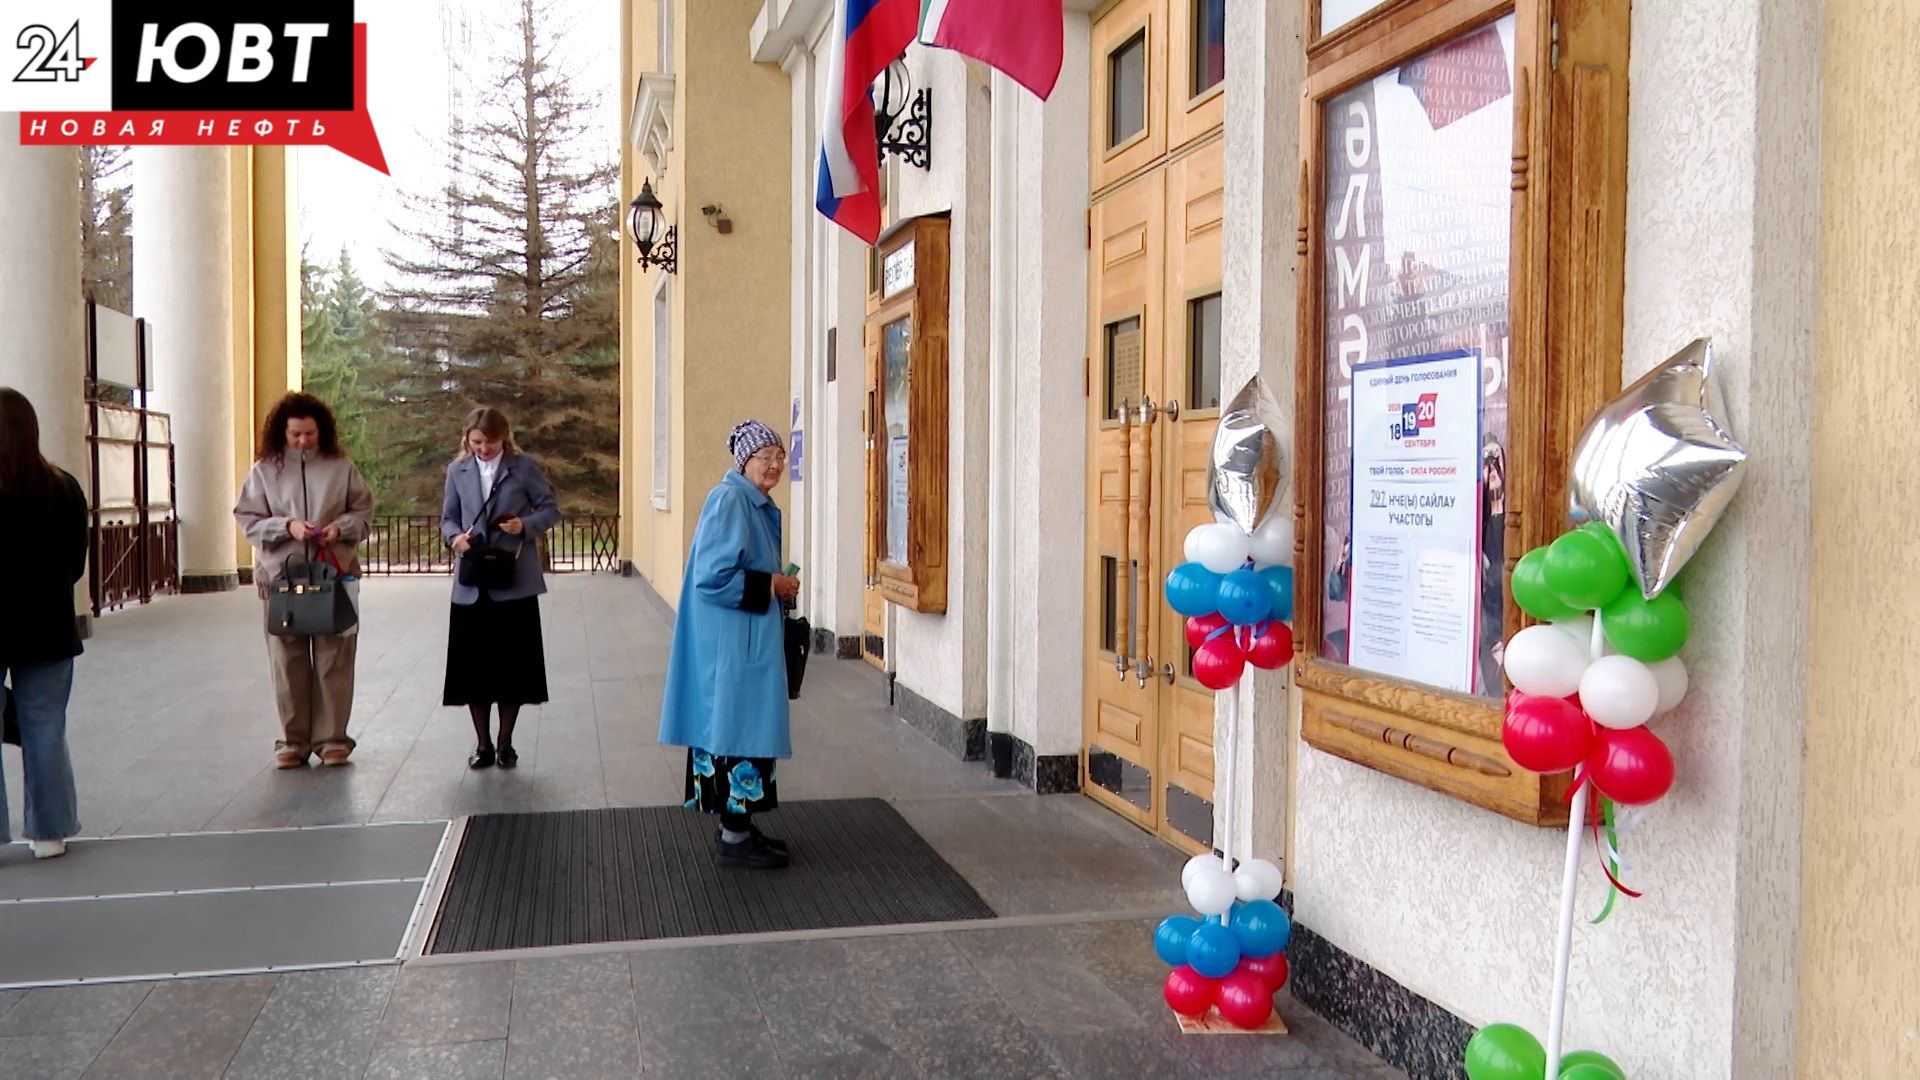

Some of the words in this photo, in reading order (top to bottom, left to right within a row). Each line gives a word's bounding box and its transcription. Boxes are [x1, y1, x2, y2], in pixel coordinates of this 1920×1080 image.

[1390, 423, 1401, 441] 18
[1403, 411, 1417, 430] 19
[1418, 400, 1434, 421] 20
[1419, 493, 1456, 508] САЙЛАУ
[1388, 512, 1434, 527] УЧАСТОГЫ
